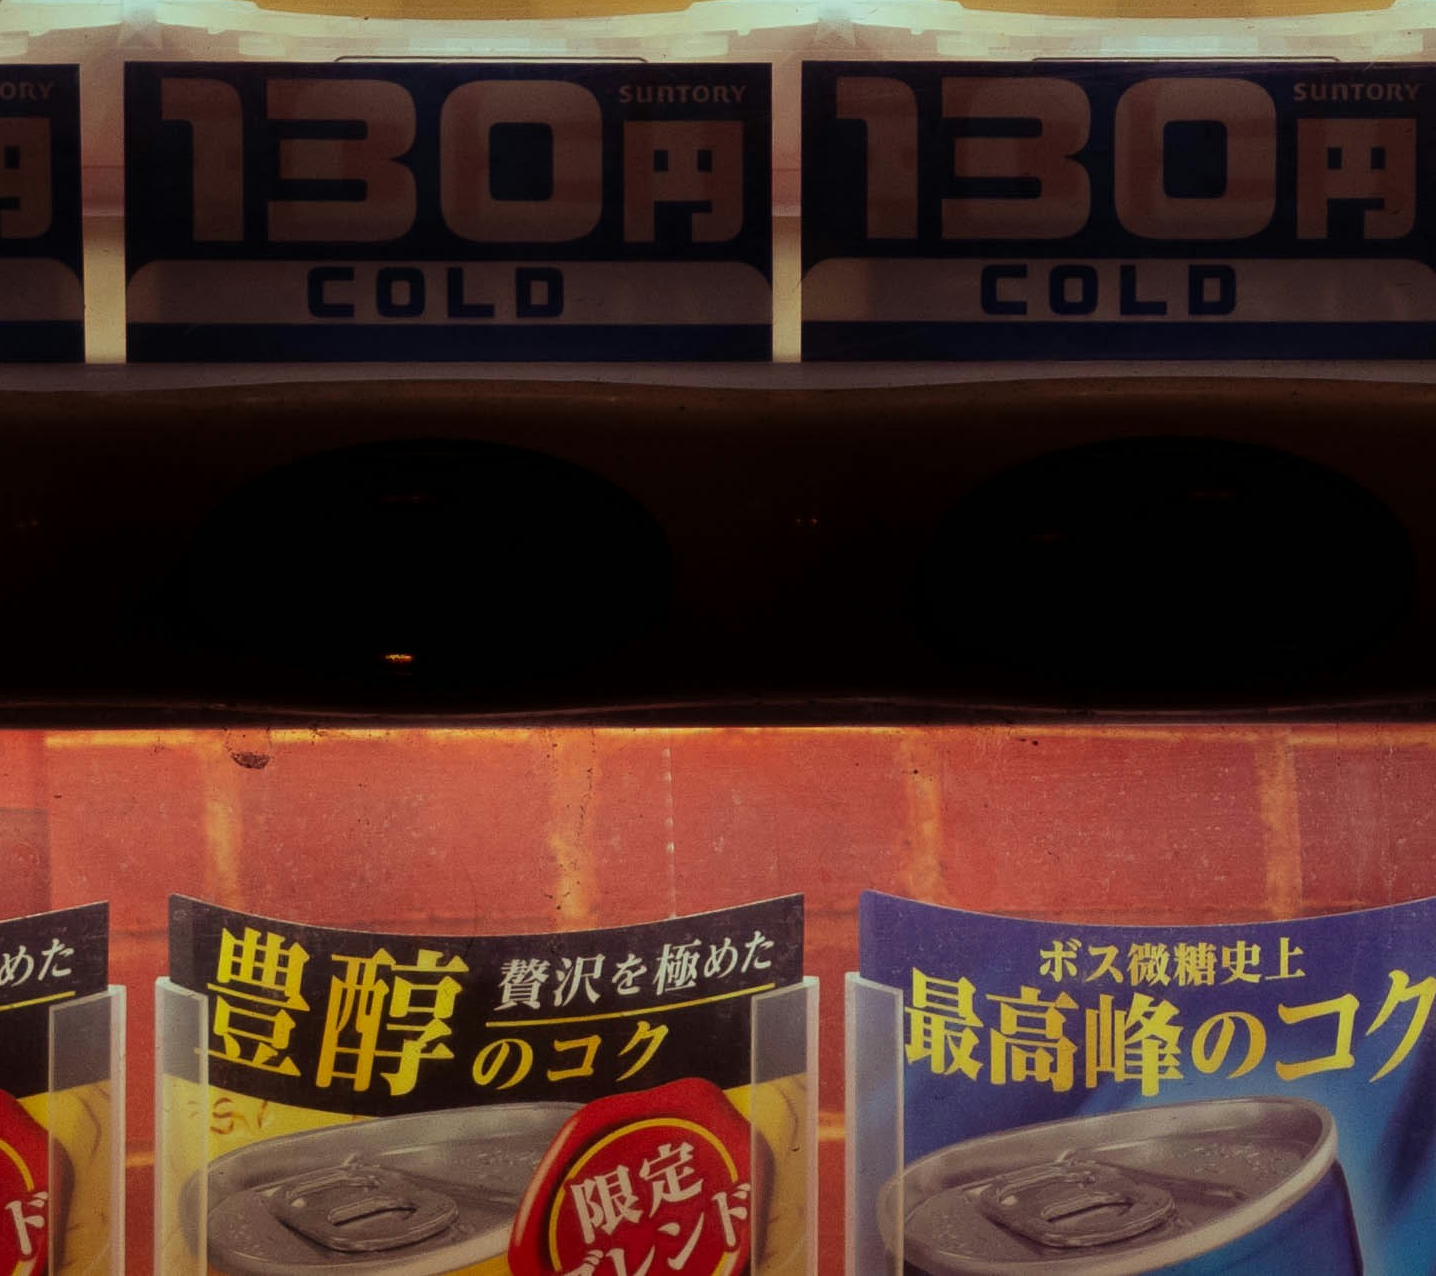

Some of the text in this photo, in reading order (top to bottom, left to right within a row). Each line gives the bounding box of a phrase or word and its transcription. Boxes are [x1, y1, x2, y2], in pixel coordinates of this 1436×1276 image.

[306, 267, 563, 321] COLD
[980, 264, 1237, 318] COLD
[494, 930, 775, 1013] 贅沢を極めた
[1039, 937, 1307, 987] ボス微糖史上
[196, 927, 469, 1097] 豊醇
[471, 1020, 670, 1090] のコク
[570, 1142, 703, 1244] 限定
